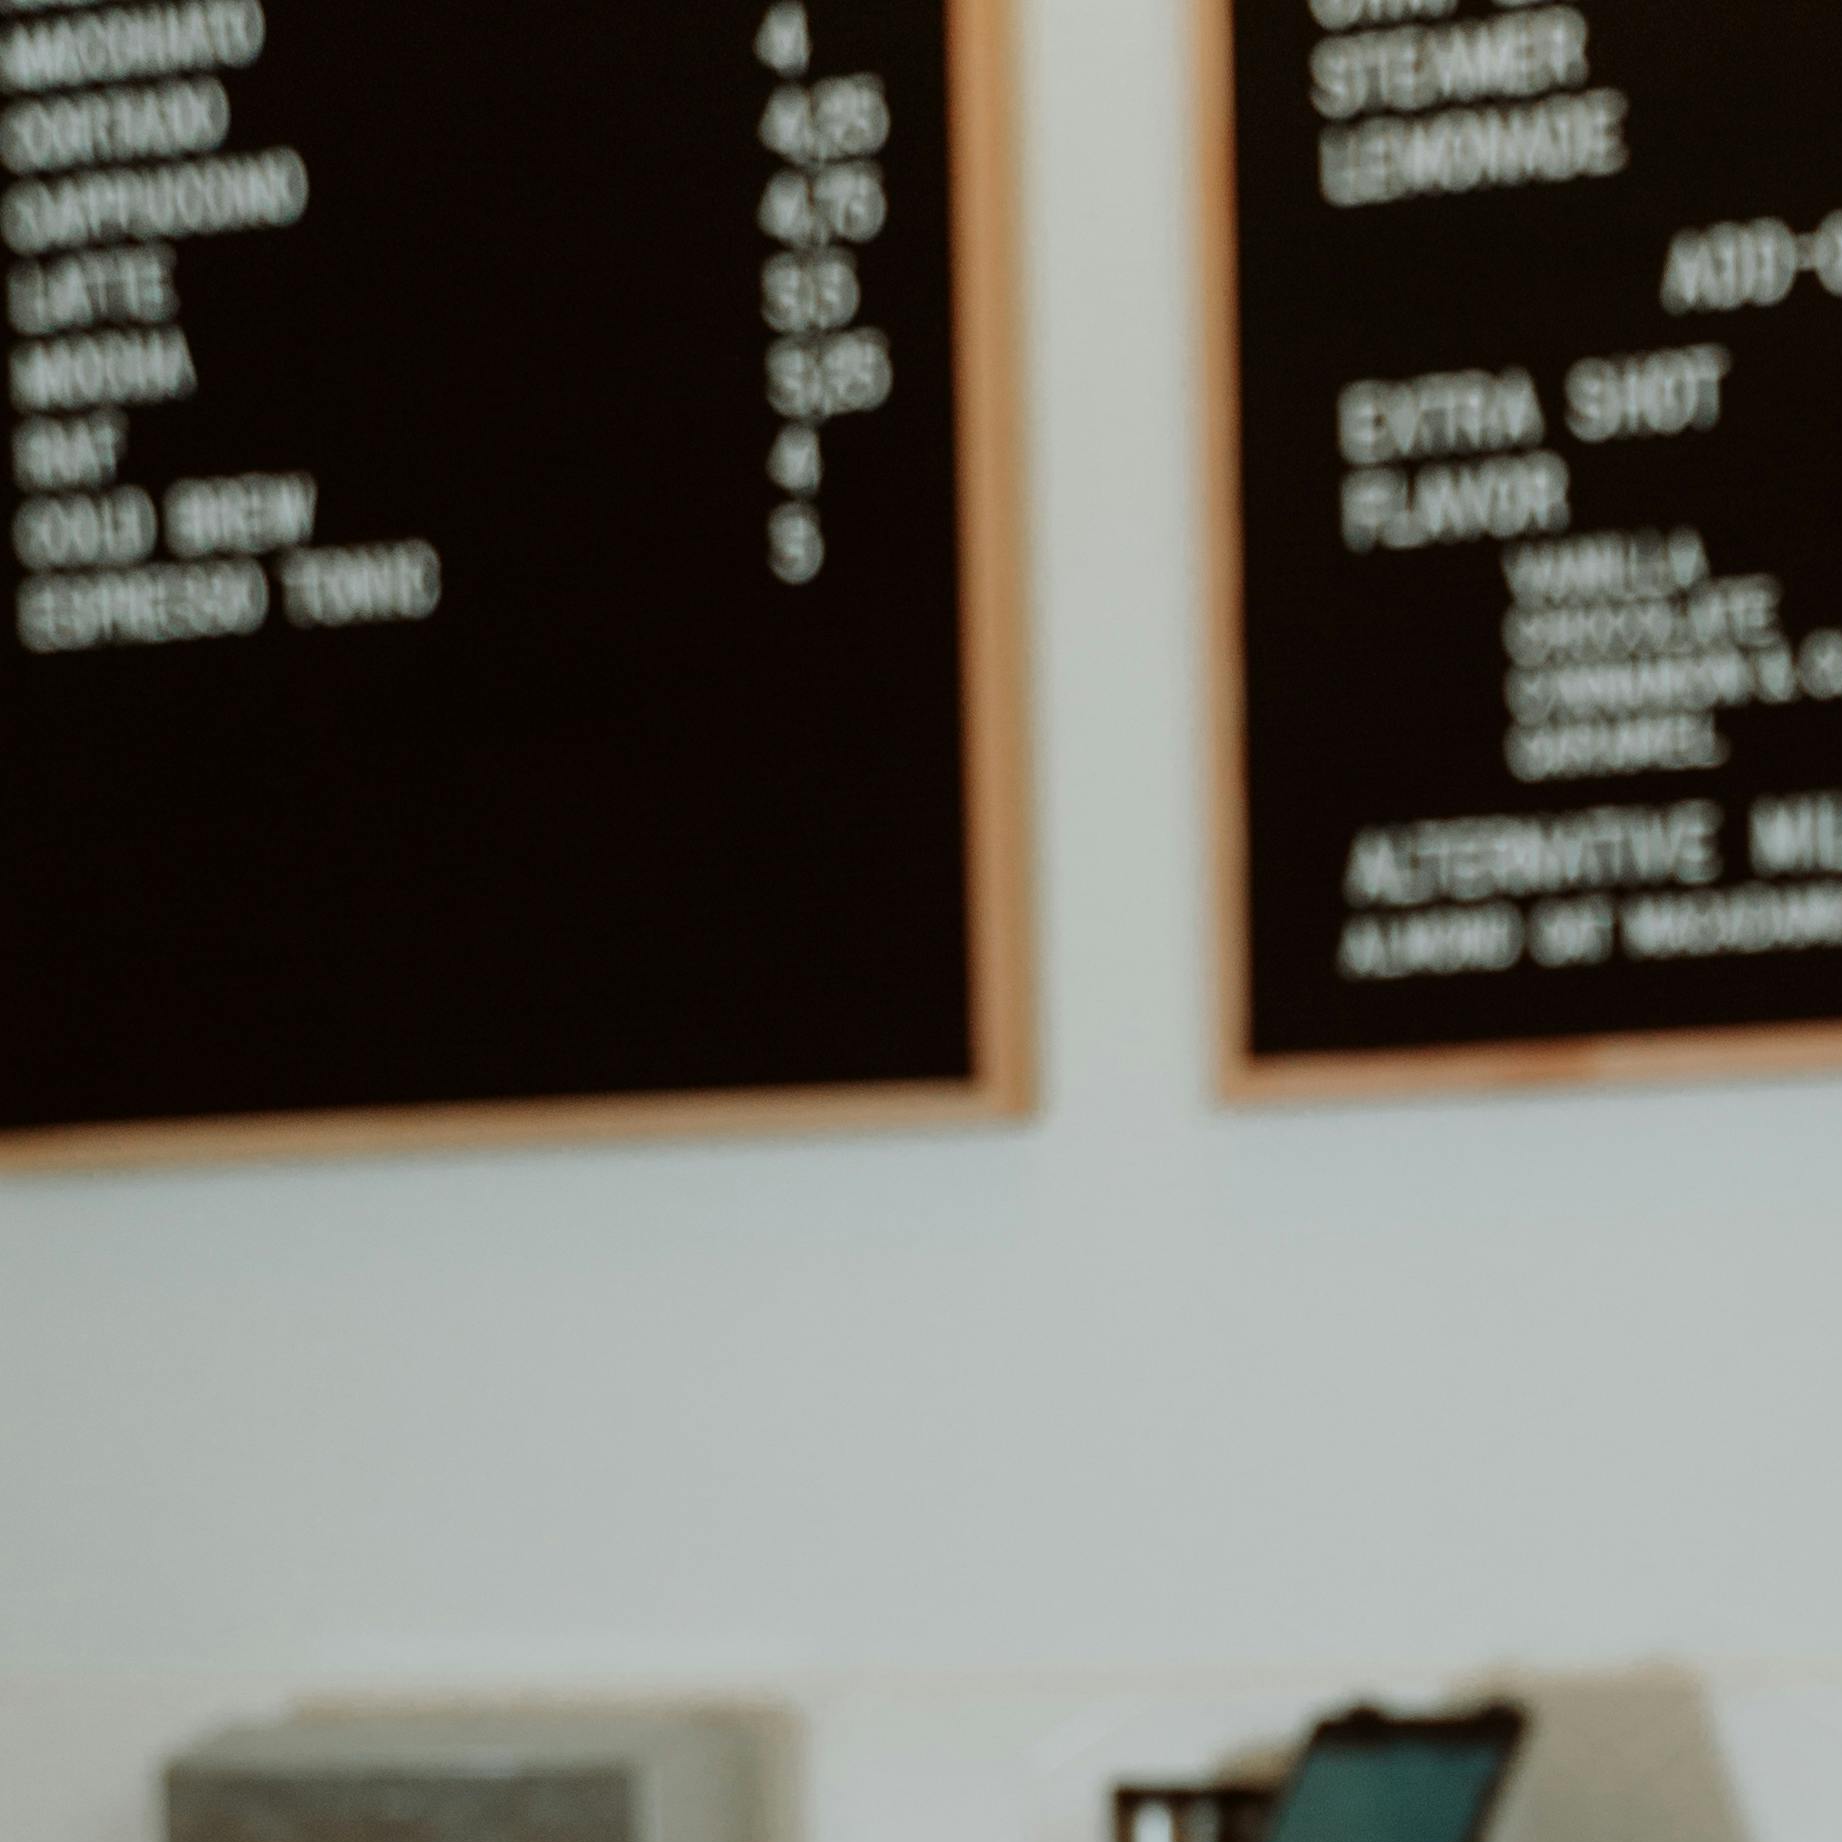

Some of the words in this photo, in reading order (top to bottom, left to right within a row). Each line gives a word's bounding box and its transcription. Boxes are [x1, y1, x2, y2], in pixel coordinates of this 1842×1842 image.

[1313, 10, 1585, 115] STEAMER
[1322, 92, 1625, 204] LEMONADE
[1340, 370, 1542, 463] EXTRA
[1566, 346, 1728, 440] SHOT
[1343, 451, 1569, 549] FLAVOR
[1347, 803, 1720, 905] ALTERNATIVE
